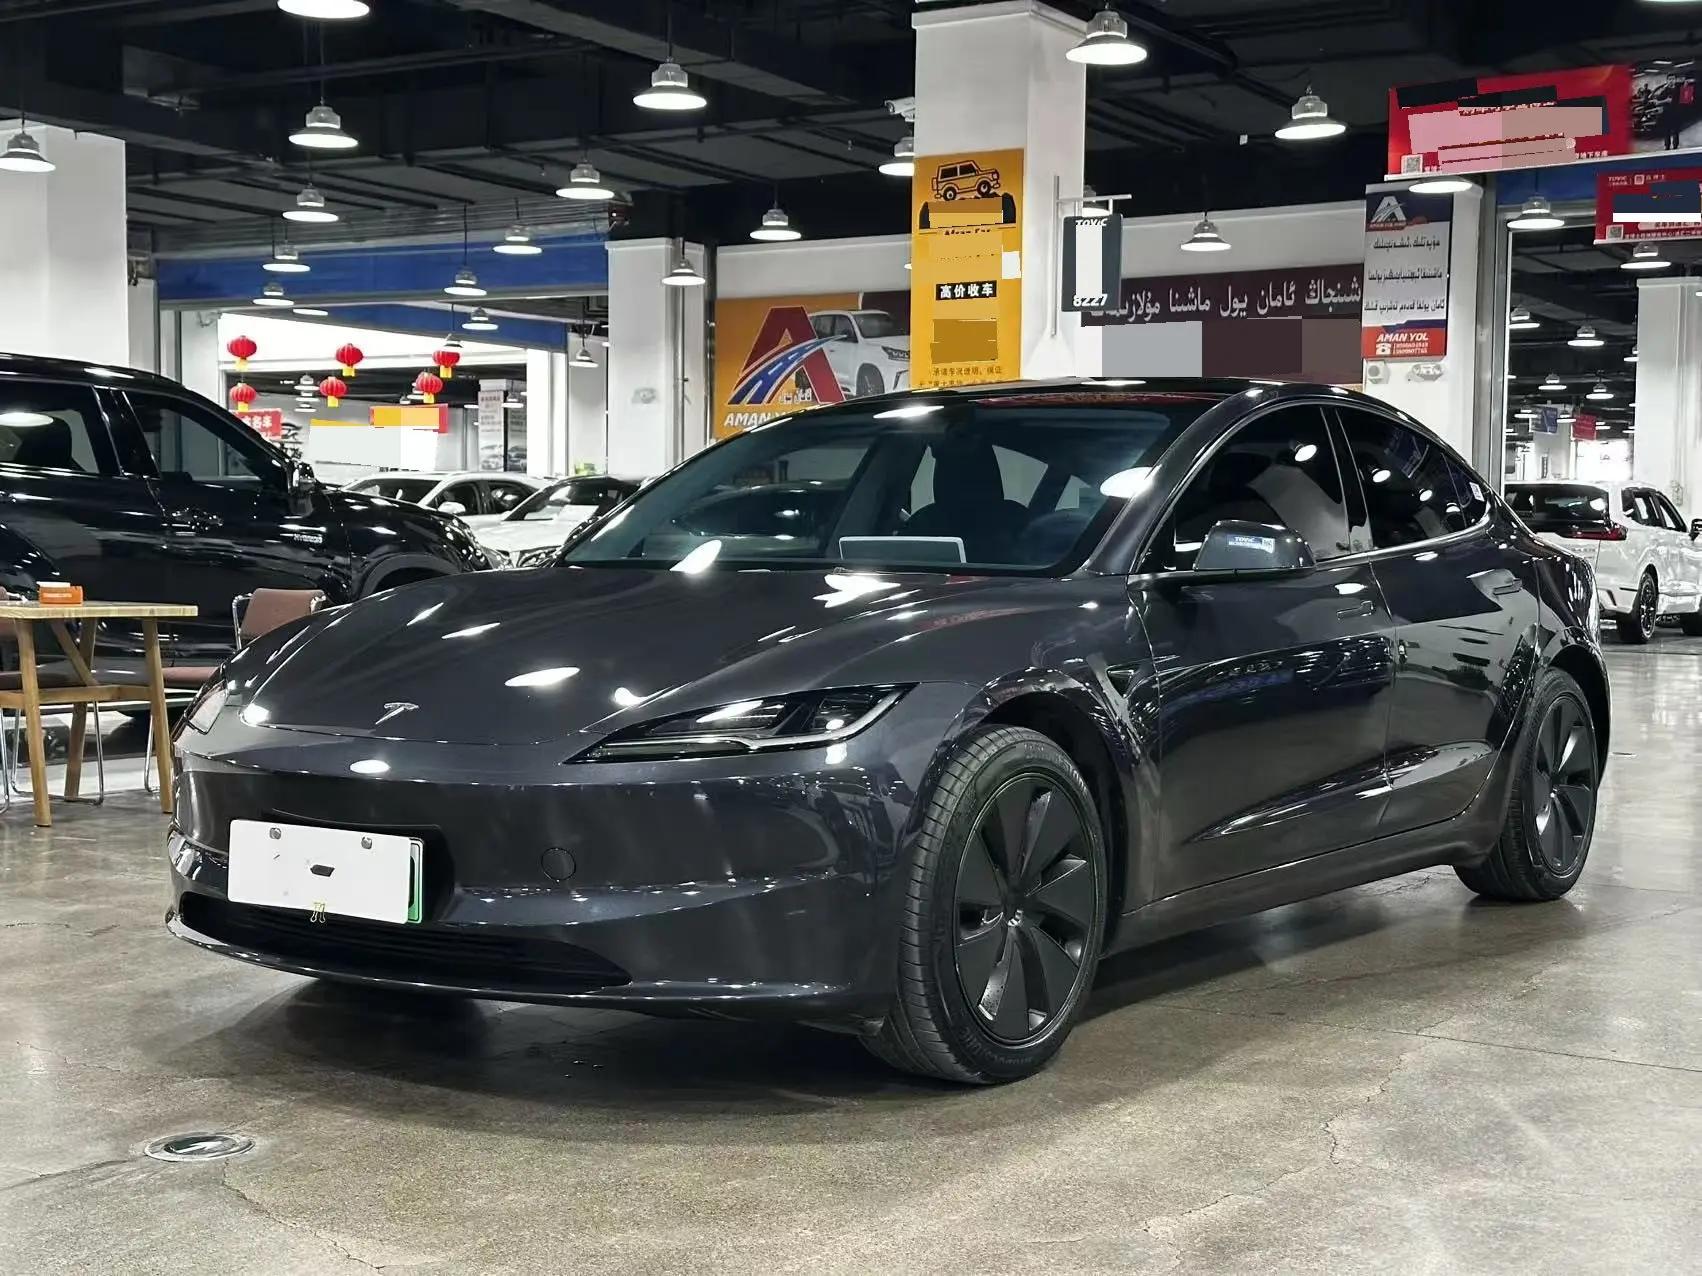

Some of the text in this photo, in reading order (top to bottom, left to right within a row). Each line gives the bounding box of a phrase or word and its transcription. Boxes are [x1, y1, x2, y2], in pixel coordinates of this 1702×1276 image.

[940, 283, 993, 299] 高价收车
[1073, 293, 1107, 307] 8227
[1376, 332, 1429, 343] AMAN YOL
[723, 411, 771, 427] AMAN
